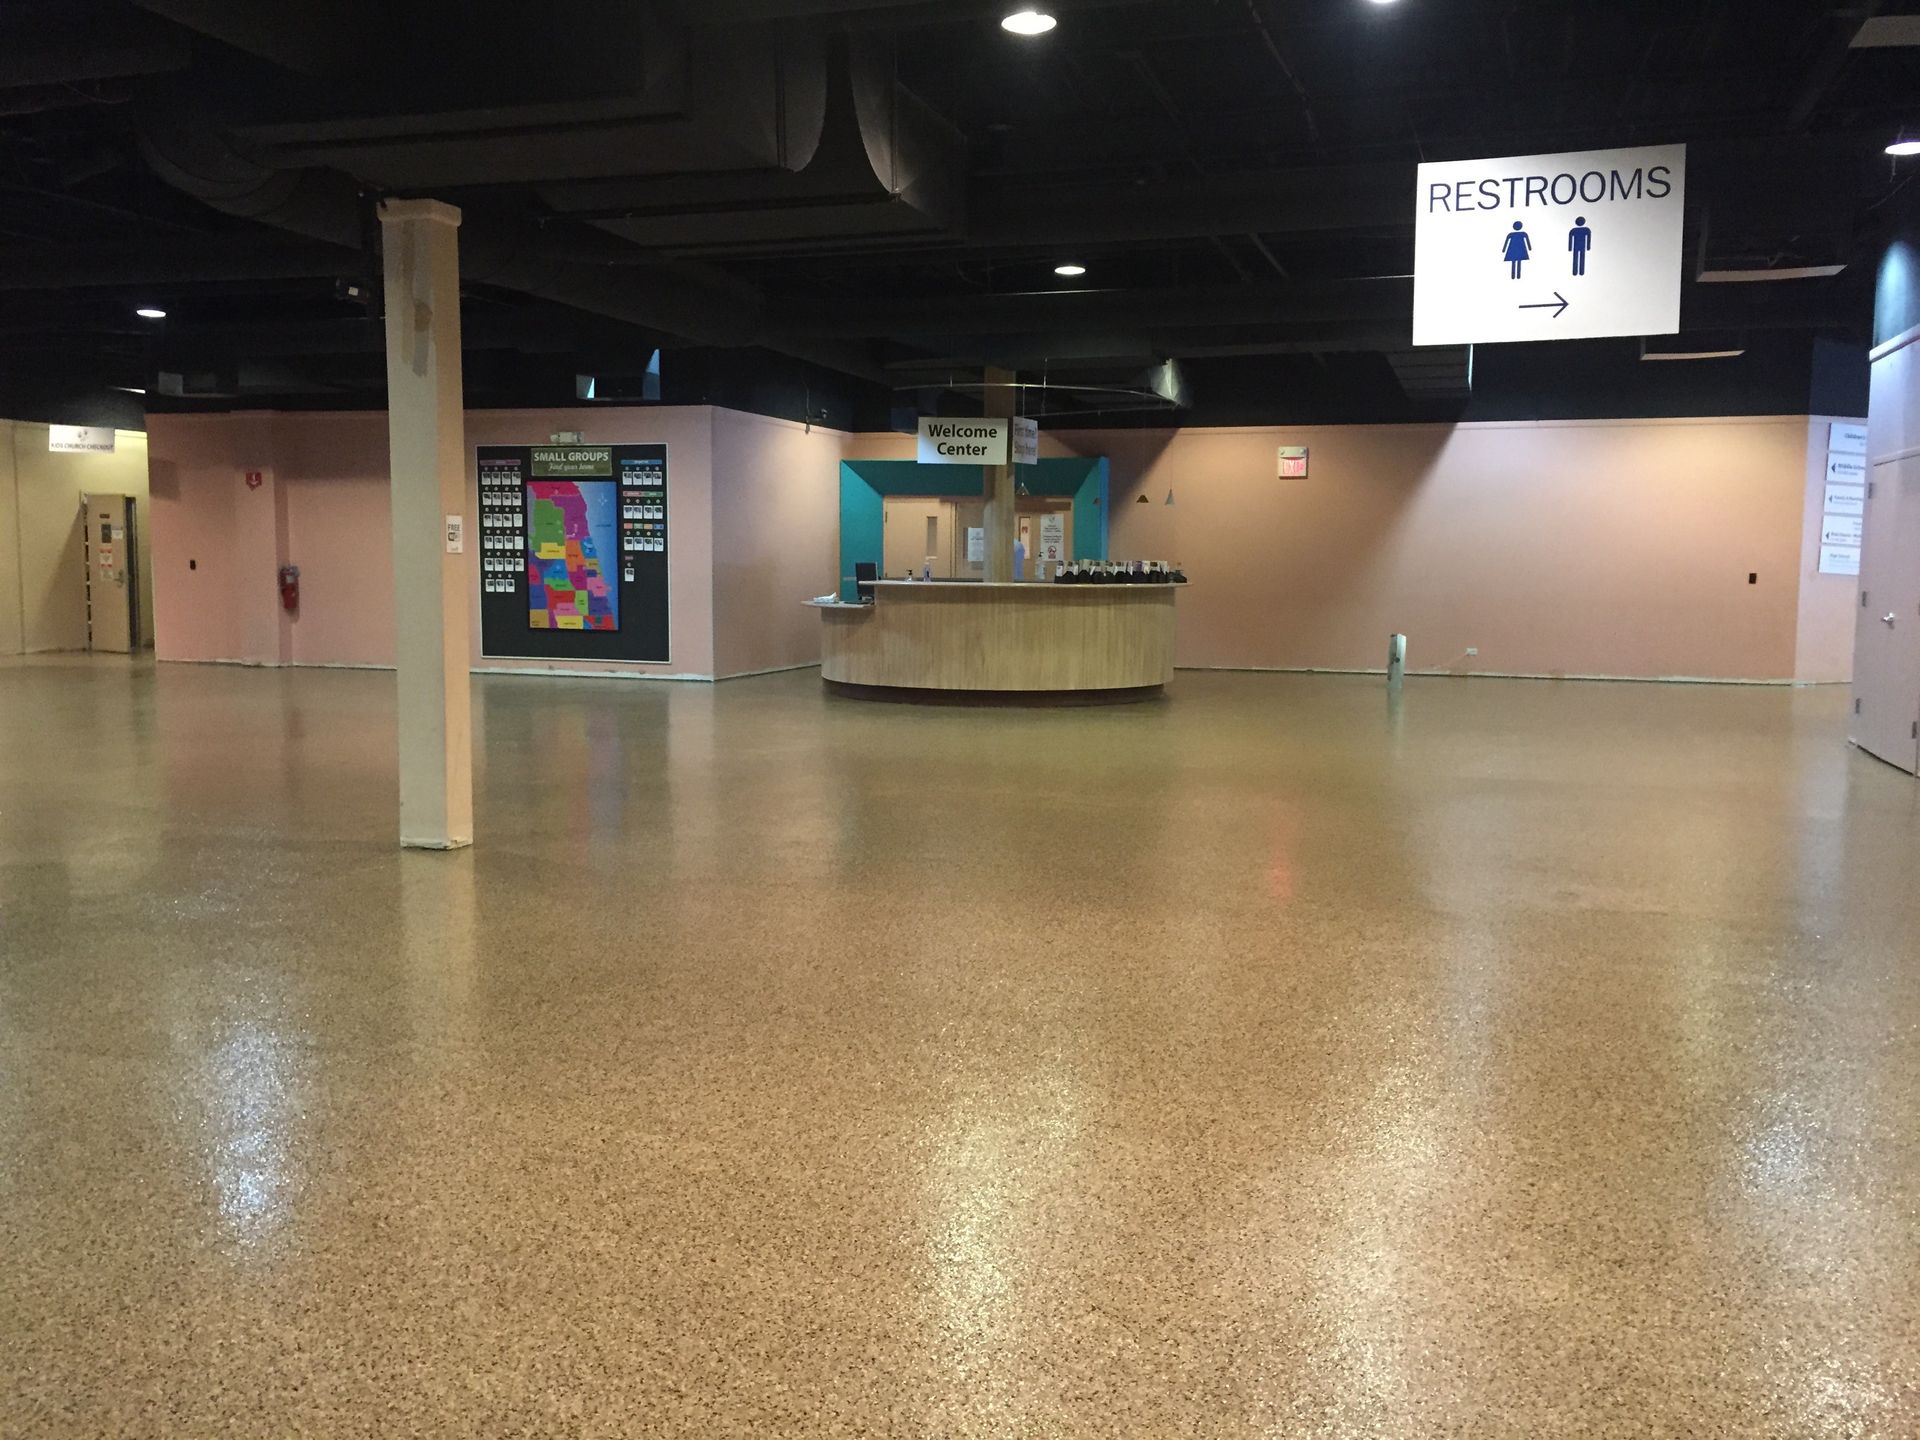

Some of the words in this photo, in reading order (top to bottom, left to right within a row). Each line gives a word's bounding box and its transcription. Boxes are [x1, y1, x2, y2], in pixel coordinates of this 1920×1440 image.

[1429, 166, 1672, 214] RESTROOMS
[928, 424, 998, 438] Welcome
[937, 442, 988, 456] Center
[534, 452, 567, 462] SMALL
[568, 452, 609, 461] GROUPS
